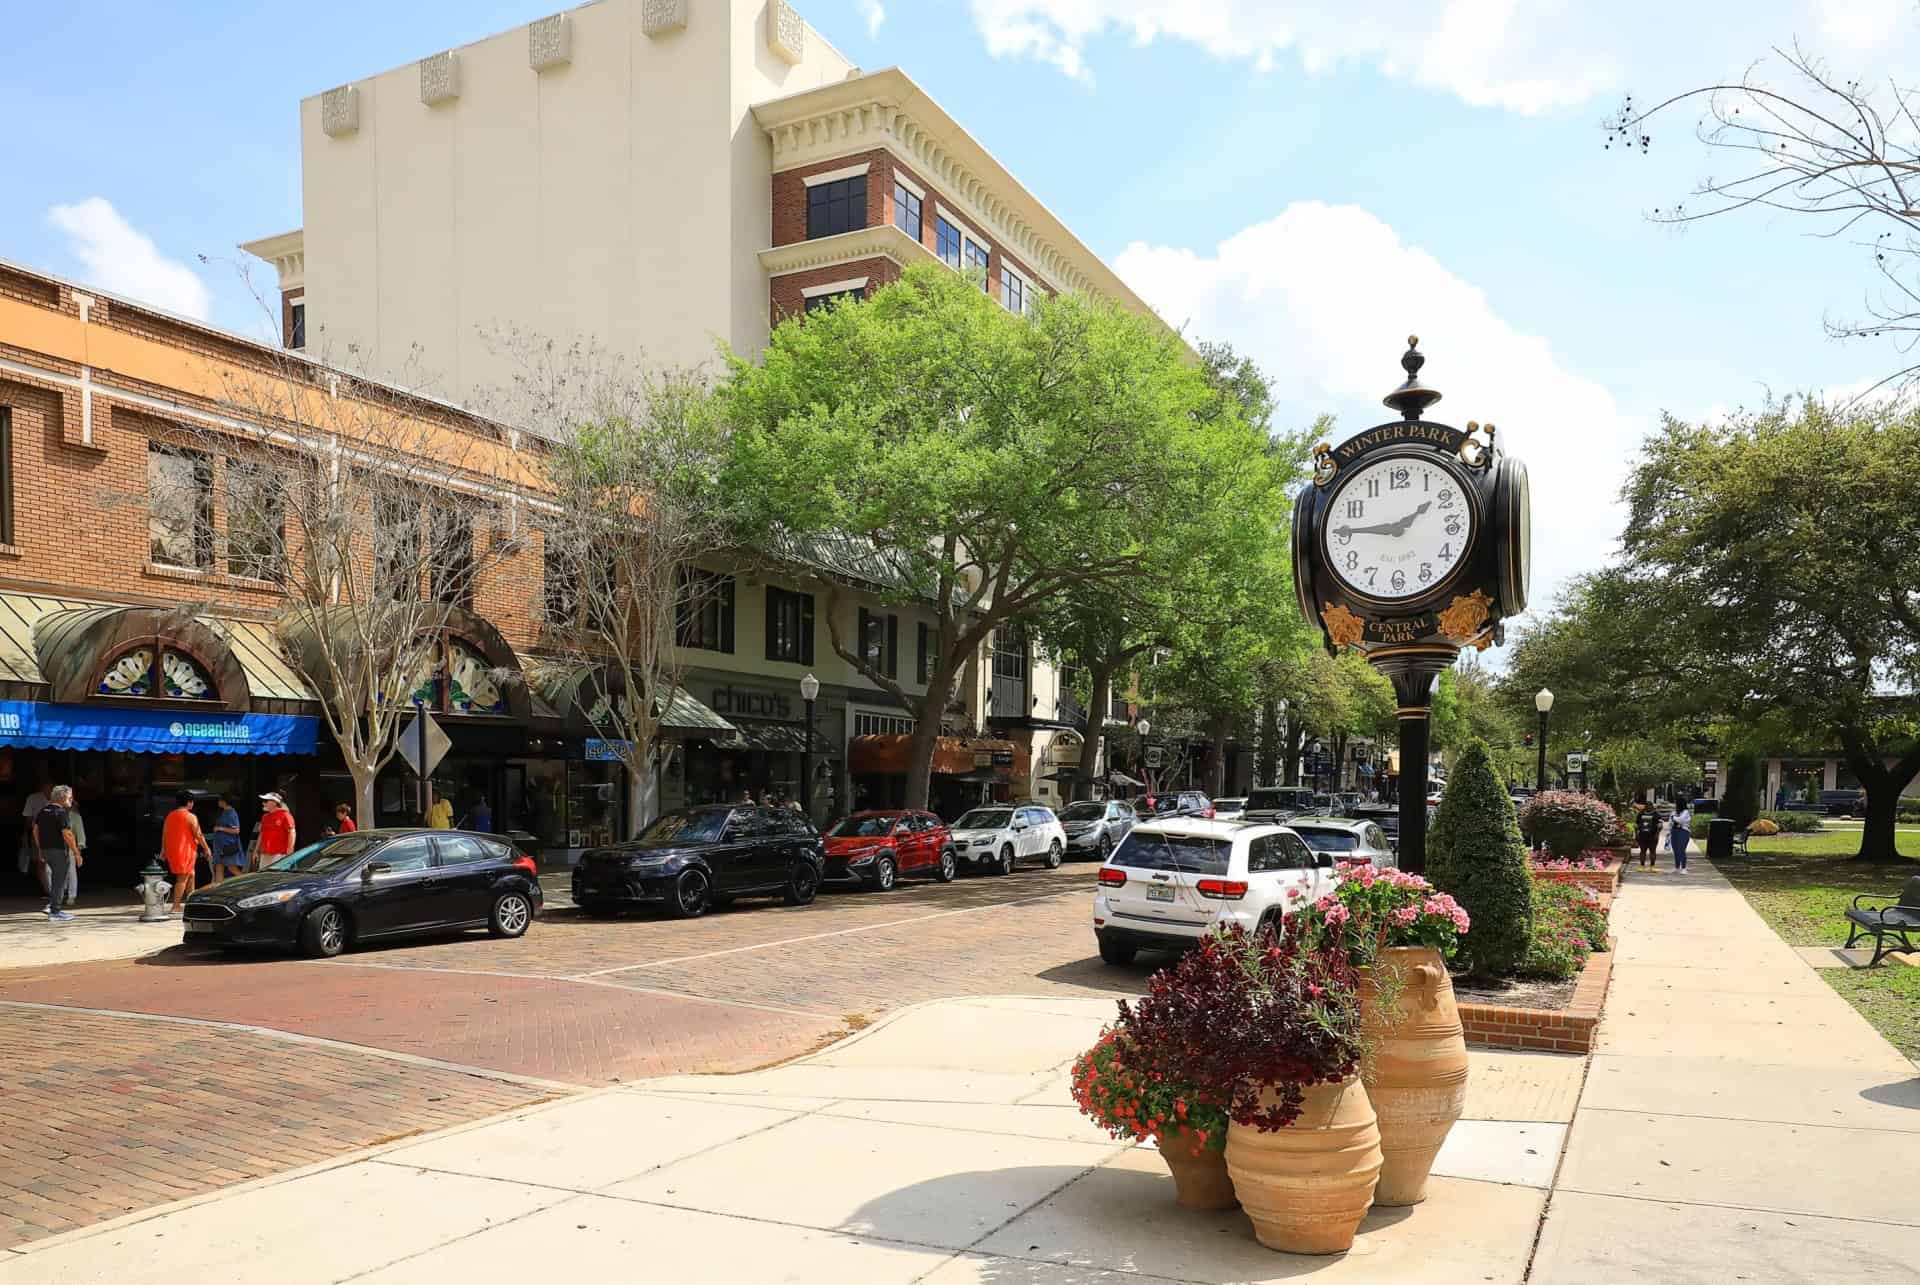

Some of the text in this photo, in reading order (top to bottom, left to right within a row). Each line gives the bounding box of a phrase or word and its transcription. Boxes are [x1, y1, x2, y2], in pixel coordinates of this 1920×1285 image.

[1341, 424, 1452, 457] WINTER PARK
[1368, 479, 1379, 498] 11
[1390, 469, 1411, 490] 12
[1424, 473, 1429, 491] 1
[1347, 500, 1363, 518] 10
[1437, 489, 1453, 509] 2
[1444, 514, 1461, 535] 3
[1347, 550, 1358, 570] 8
[1438, 542, 1453, 562] 4
[1364, 566, 1378, 586] 7
[1391, 570, 1406, 590] 6
[1418, 562, 1432, 582] 5
[1369, 617, 1428, 633] CENTRAL
[1382, 631, 1416, 642] PARK
